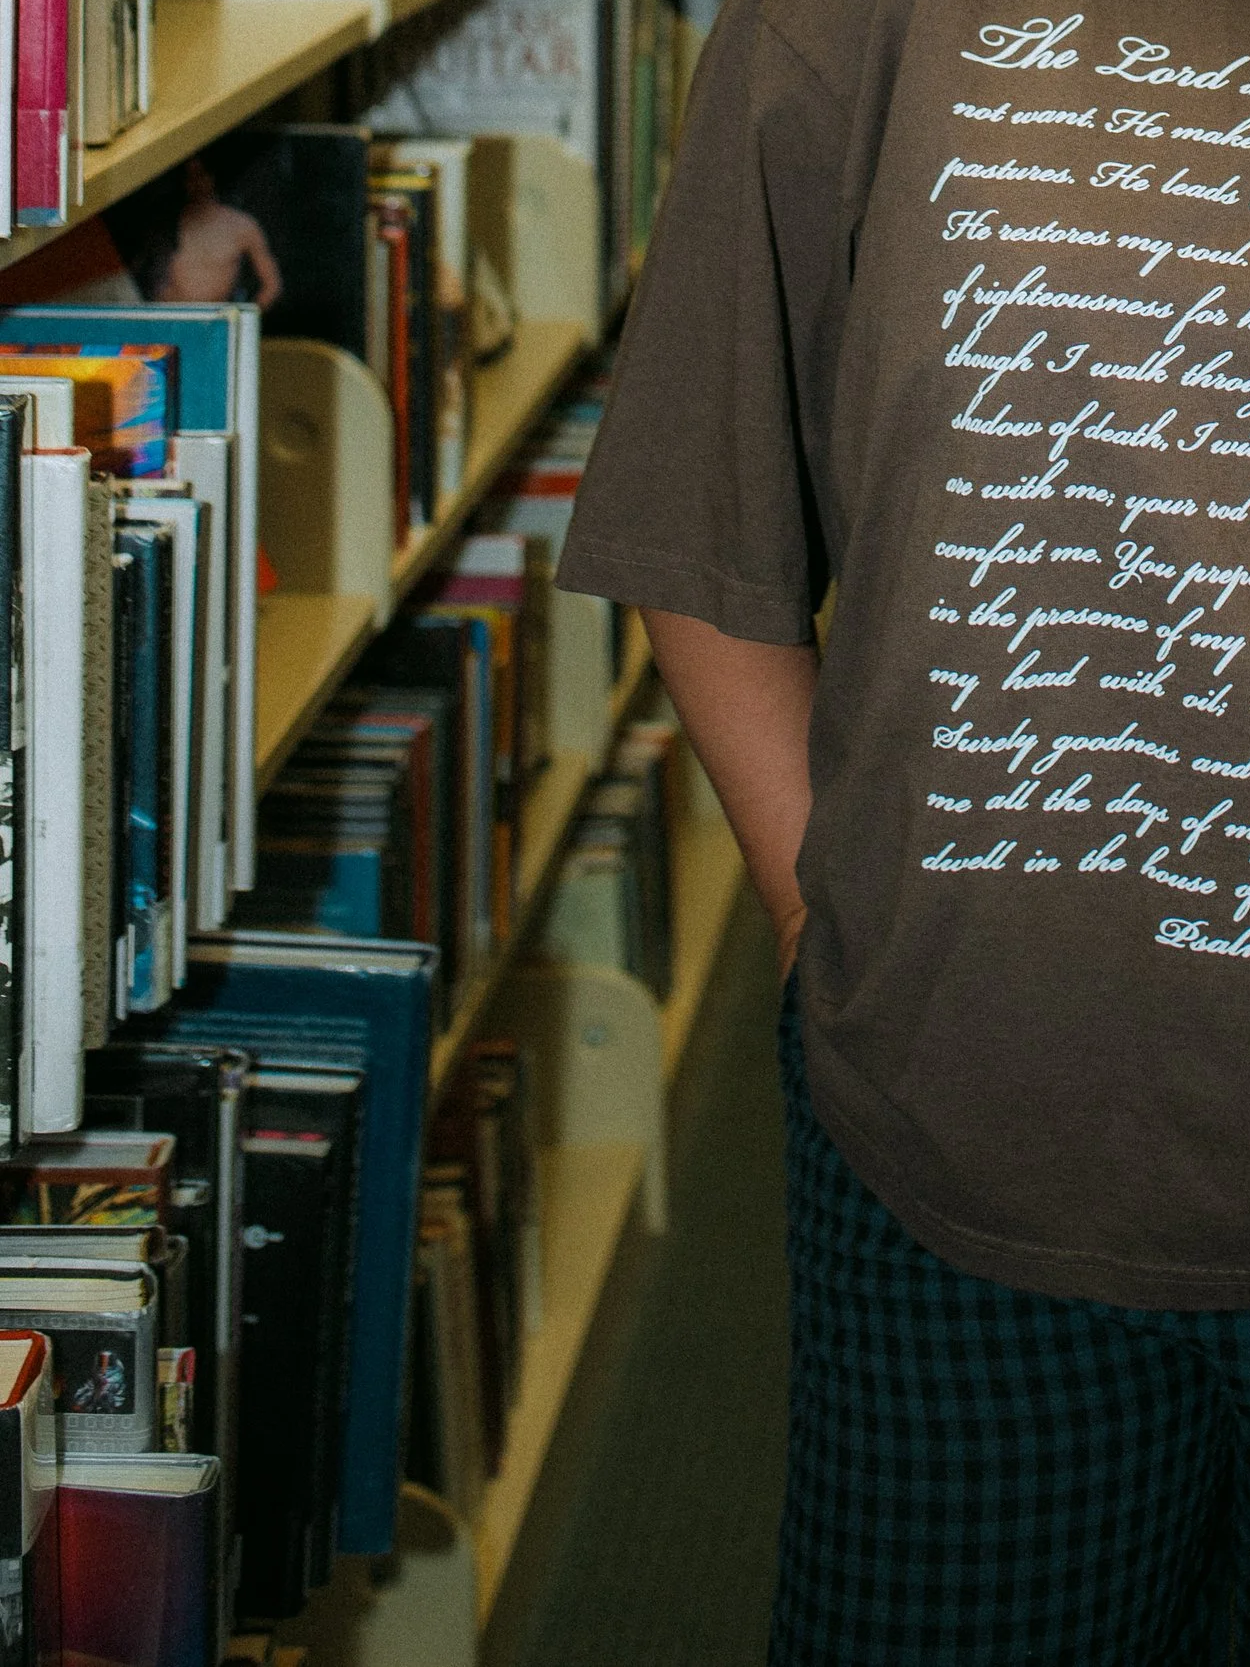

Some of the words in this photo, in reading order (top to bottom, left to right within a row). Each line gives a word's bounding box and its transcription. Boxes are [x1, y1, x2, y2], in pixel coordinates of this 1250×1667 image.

[960, 14, 1084, 69] The
[1095, 37, 1250, 89] Lord
[953, 102, 1011, 122] not
[1011, 108, 1098, 128] want.
[1104, 109, 1170, 138] He
[930, 157, 1075, 202] pastures.
[1089, 162, 1156, 191] He
[1161, 168, 1240, 205] leads
[942, 210, 999, 241] He
[998, 221, 1111, 246] restores
[1117, 235, 1173, 277] my
[942, 264, 985, 329] of
[973, 265, 1174, 330] righteousness
[1163, 285, 1229, 345] for
[945, 328, 1047, 395] though
[1046, 344, 1090, 372] I
[1090, 345, 1185, 383] walk
[951, 392, 1043, 436] shadow
[1048, 401, 1099, 462] of
[1084, 409, 1177, 452] death,
[1177, 422, 1219, 452] I
[946, 477, 973, 496] are
[981, 459, 1069, 499] with
[1064, 485, 1115, 507] me;
[1119, 496, 1198, 533] your
[935, 523, 1047, 587] comfort
[1050, 547, 1102, 563] me.
[1109, 542, 1177, 589] You
[929, 599, 960, 623] in
[968, 587, 1017, 627] the
[1007, 608, 1149, 654] presence
[1156, 607, 1204, 662] of
[1190, 633, 1246, 676] my
[929, 670, 980, 712] my
[1001, 650, 1089, 690] head
[1100, 664, 1176, 697] with
[1182, 684, 1233, 717] oil;
[932, 718, 1038, 773] Surely
[1031, 723, 1180, 775] goodness
[927, 794, 972, 813] me
[985, 780, 1041, 810] all
[1042, 774, 1092, 812] the
[1105, 783, 1169, 838] days
[1180, 800, 1233, 855] of
[921, 841, 1017, 872] dwell
[1023, 850, 1061, 872] in
[1078, 834, 1127, 872] the
[1140, 846, 1217, 894] house
